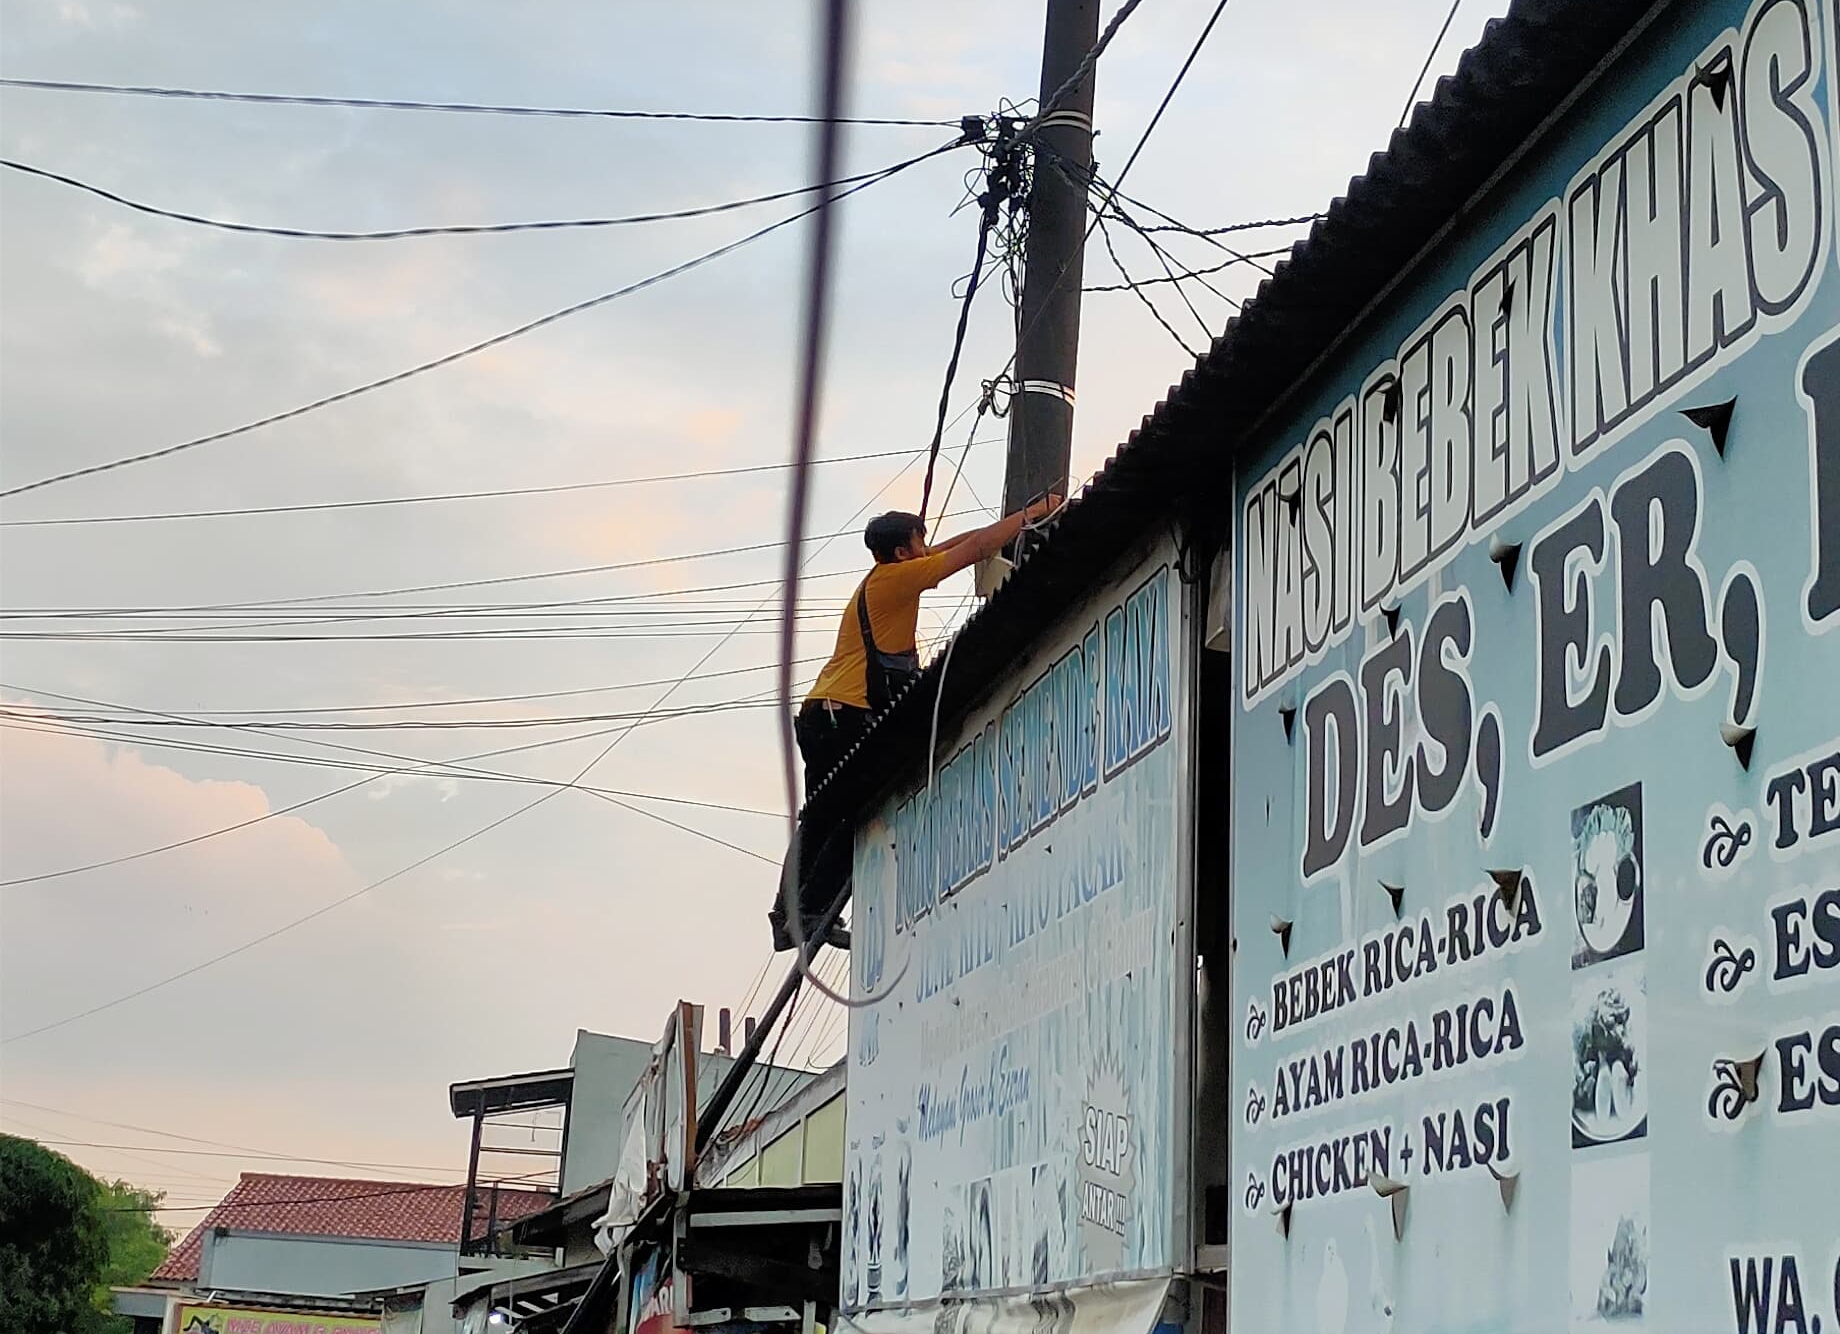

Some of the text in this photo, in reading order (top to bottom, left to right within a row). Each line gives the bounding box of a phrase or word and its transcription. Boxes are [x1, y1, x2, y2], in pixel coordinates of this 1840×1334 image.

[1245, 405, 1355, 700] NASI
[1359, 207, 1563, 613] BEBEK
[938, 720, 997, 904] BERAS
[998, 621, 1100, 863] SEMENDE
[1103, 561, 1172, 784] RAYA
[1301, 593, 1502, 879] DES,
[1529, 450, 1760, 759] ER,
[1271, 875, 1542, 1033] BEBEK RICA-RICA
[1271, 988, 1524, 1119] AYAM RICA-RICA
[1081, 1181, 1114, 1232] ANTAR
[1083, 1106, 1129, 1176] SIAP
[1271, 1125, 1391, 1204] CHICKEN
[1422, 1098, 1510, 1175] NASI
